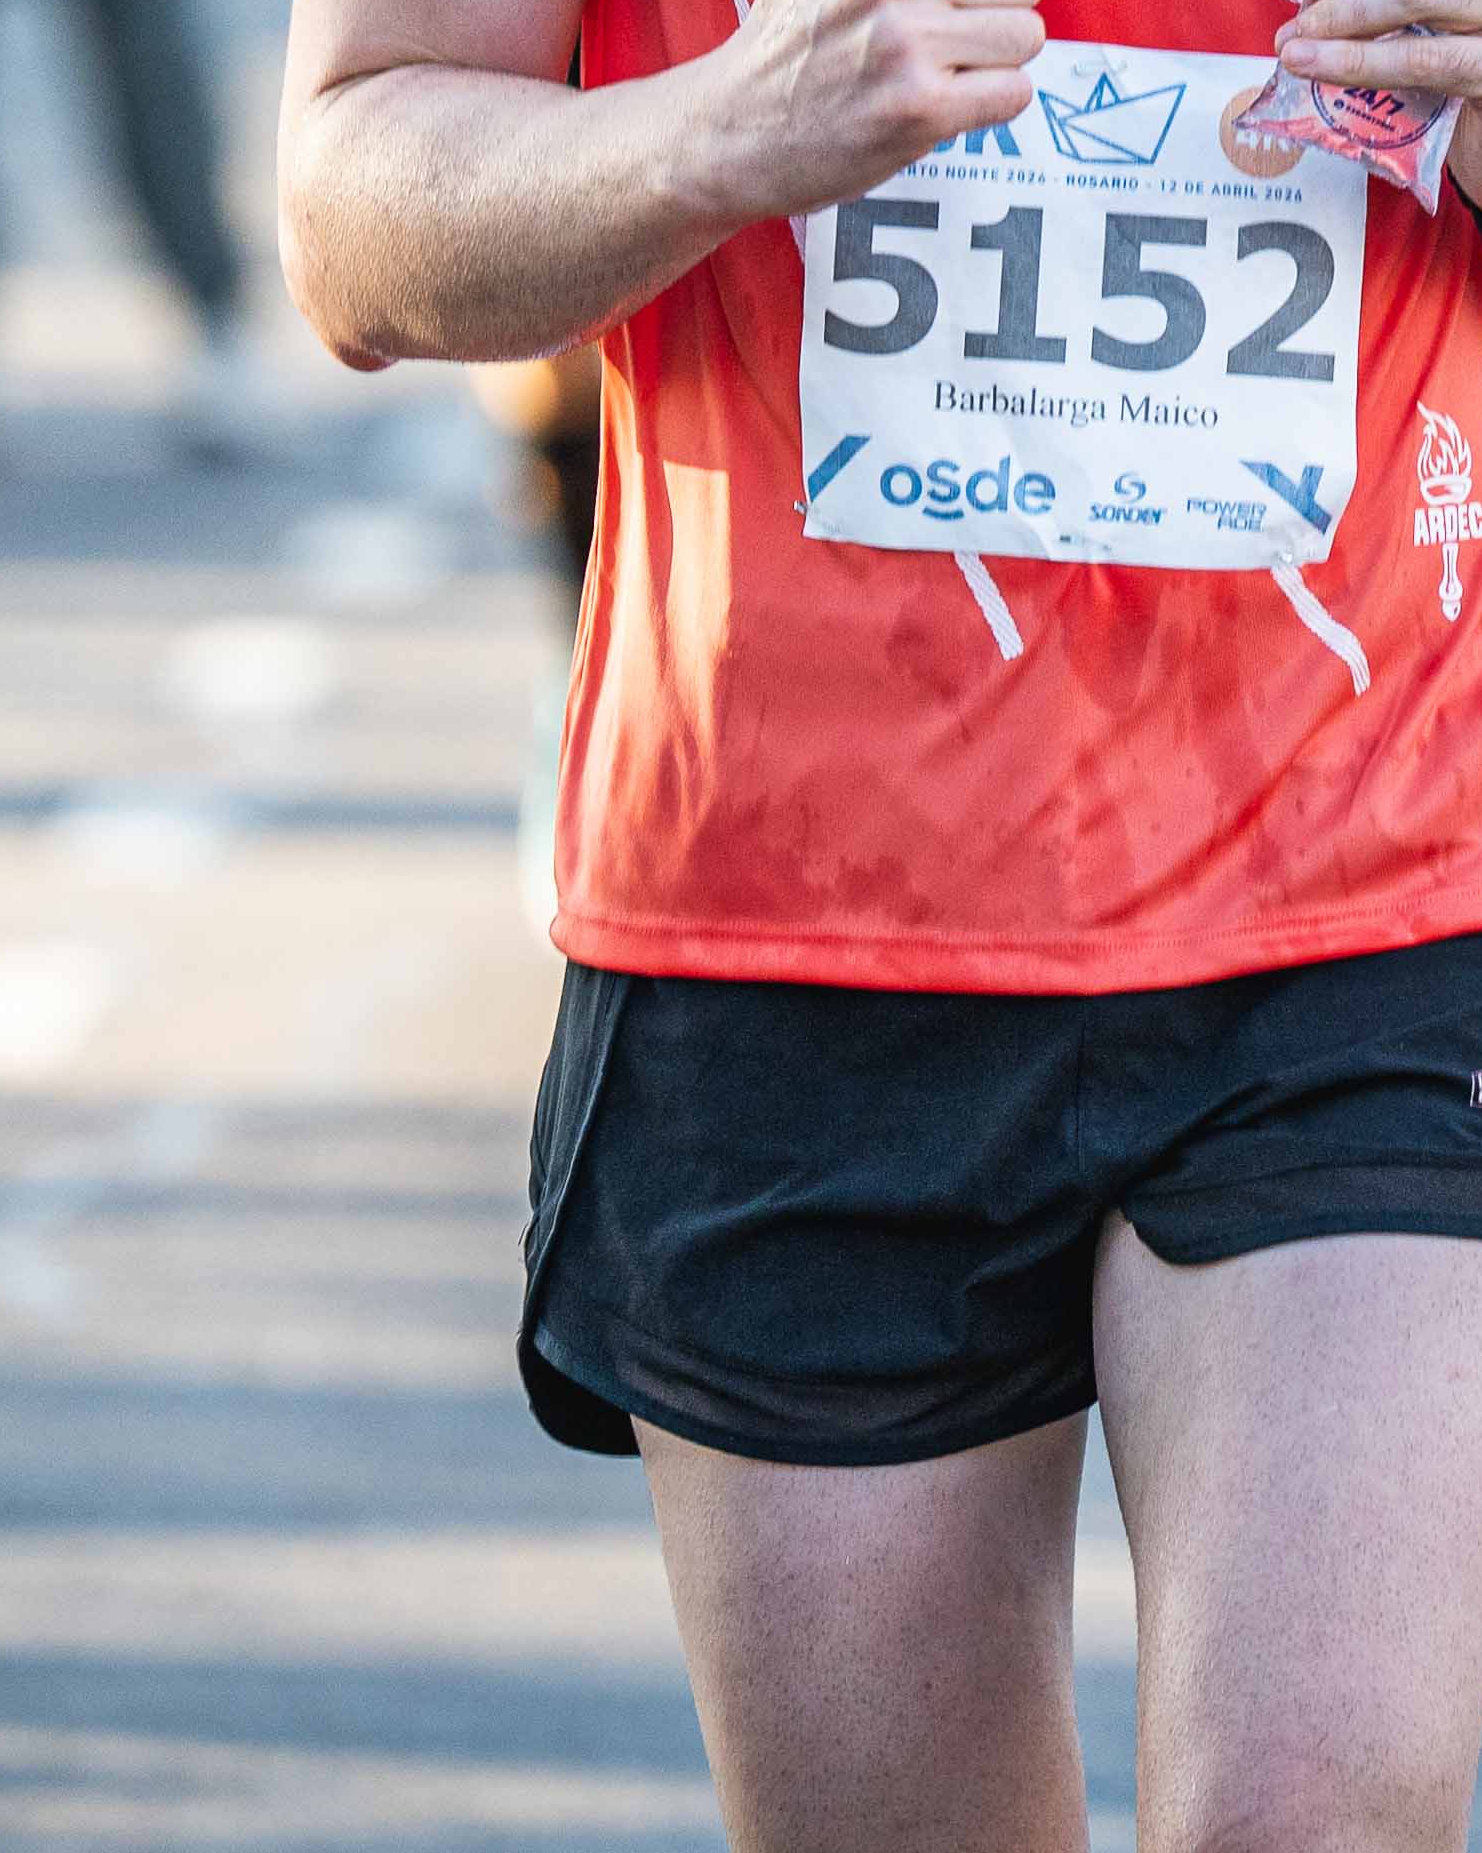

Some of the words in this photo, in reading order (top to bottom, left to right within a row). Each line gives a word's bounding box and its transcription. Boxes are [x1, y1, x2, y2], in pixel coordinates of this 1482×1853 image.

[945, 165, 999, 181] NORTE
[1066, 173, 1139, 191] ROSARIO
[1160, 179, 1177, 193] 12
[1184, 180, 1205, 195] DE
[1212, 182, 1256, 199] ABRIL
[1264, 187, 1303, 203] 2026
[822, 196, 1337, 384] 5152
[933, 380, 1106, 428] Barbalarga
[1120, 394, 1219, 429] Maico
[879, 454, 1057, 516] osde
[1186, 498, 1268, 516] POWER
